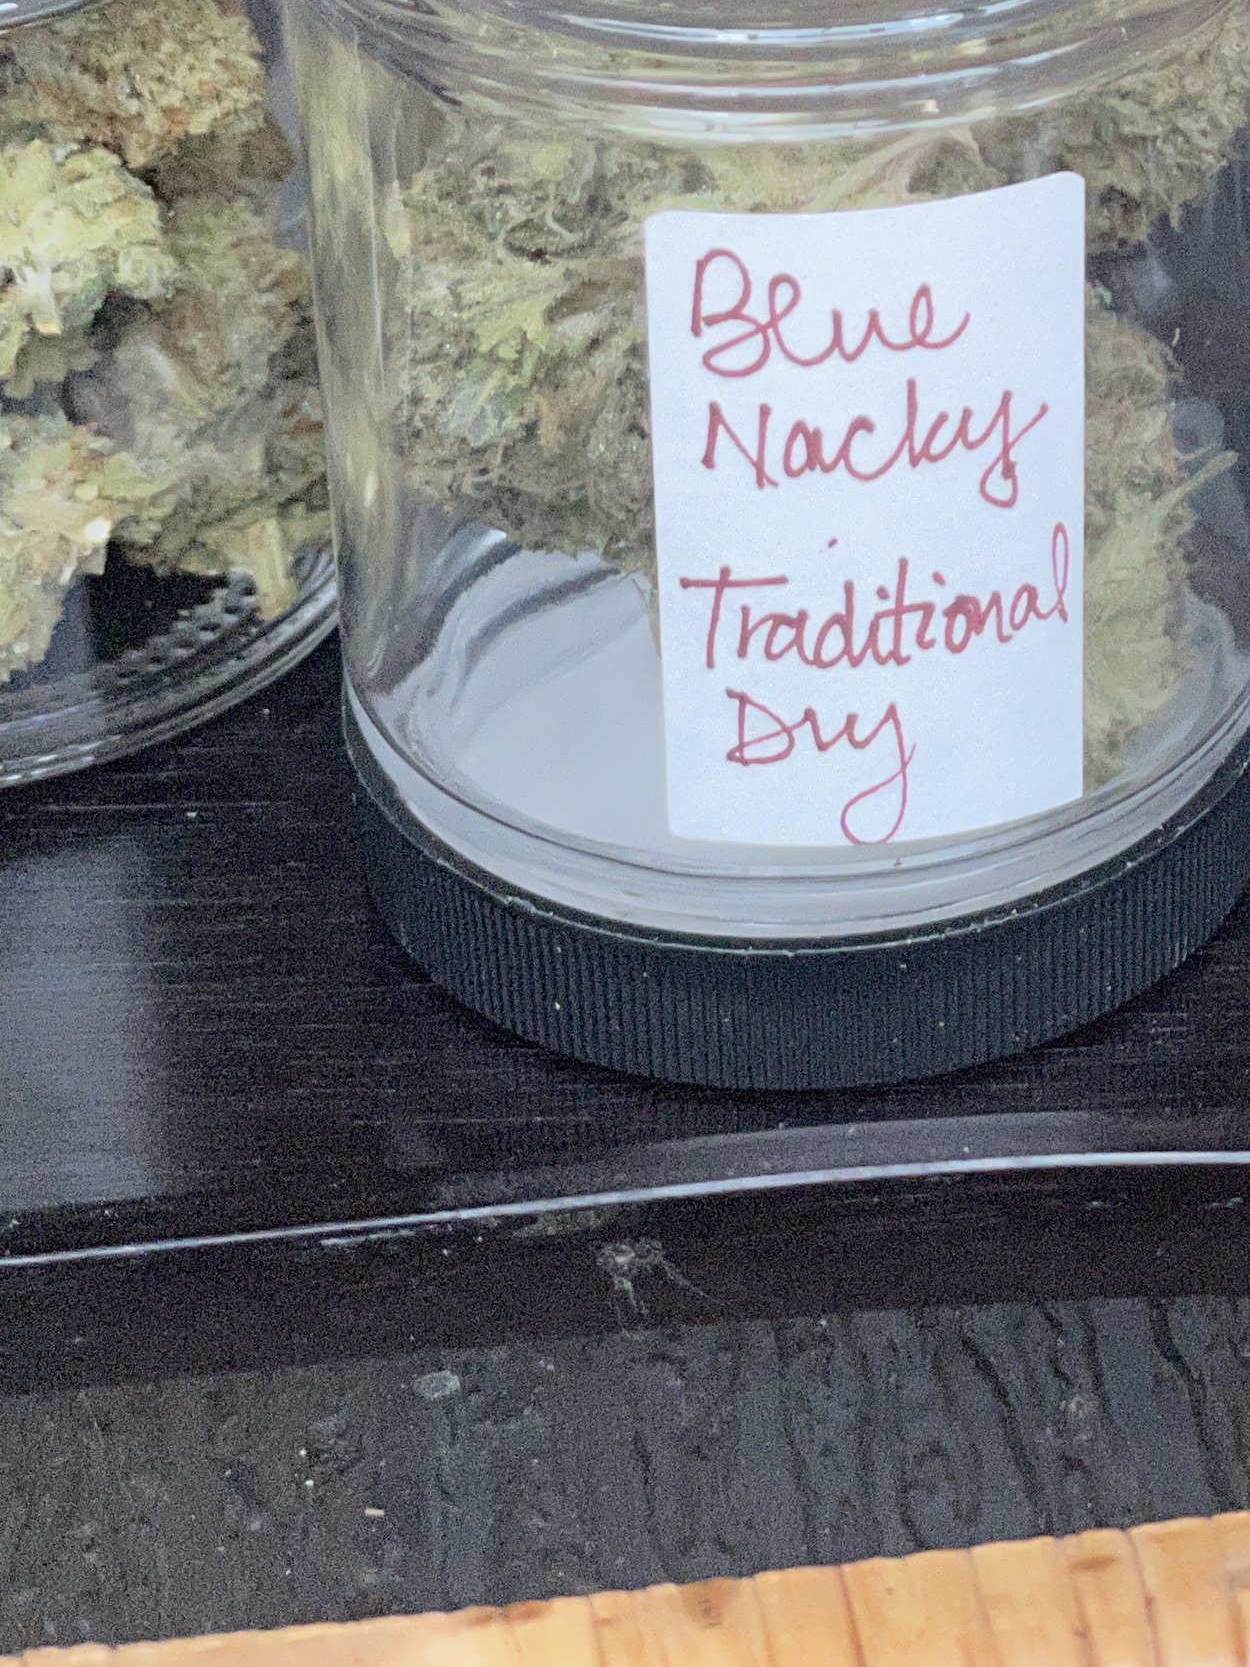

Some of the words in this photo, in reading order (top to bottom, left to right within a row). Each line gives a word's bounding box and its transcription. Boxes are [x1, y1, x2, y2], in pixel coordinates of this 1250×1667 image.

[689, 248, 971, 377] Blue
[700, 377, 1050, 509] Nacky
[679, 522, 1070, 670] Traditional
[725, 687, 917, 846] Dry
